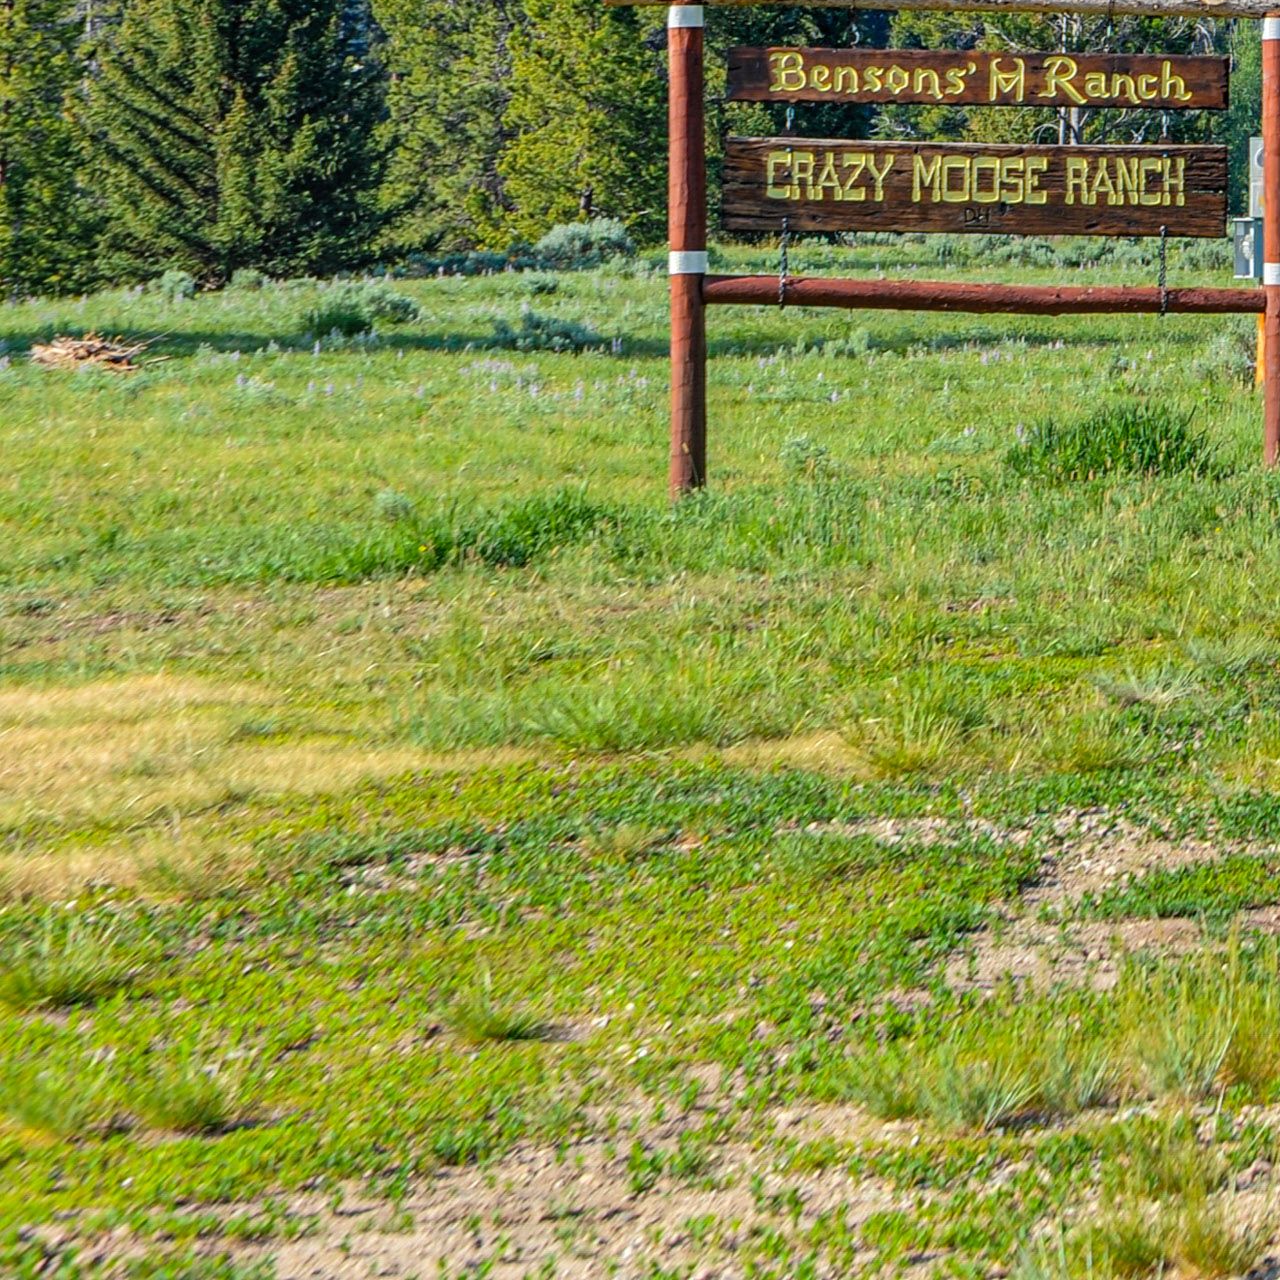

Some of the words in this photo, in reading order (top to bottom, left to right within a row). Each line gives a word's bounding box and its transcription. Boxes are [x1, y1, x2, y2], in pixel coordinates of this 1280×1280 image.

[769, 52, 977, 99] Bensons'
[1040, 56, 1192, 105] Ranch
[766, 150, 895, 202] CRAZY
[911, 153, 1049, 205] MOOSE
[1065, 156, 1186, 207] RANCH
